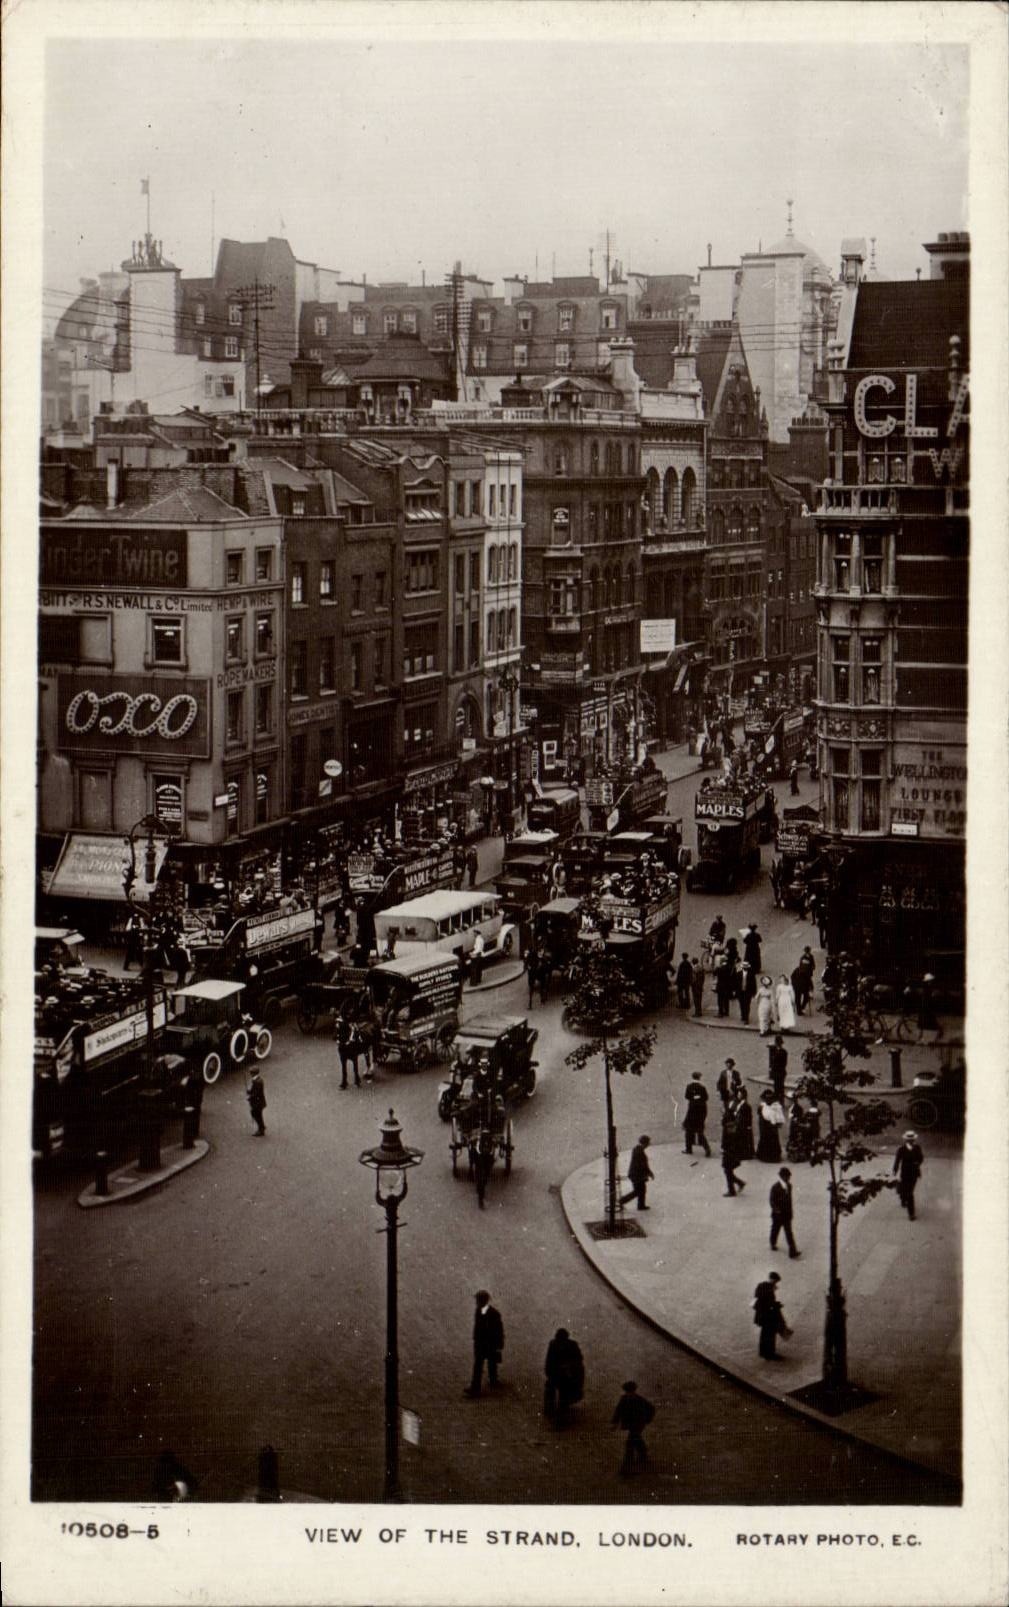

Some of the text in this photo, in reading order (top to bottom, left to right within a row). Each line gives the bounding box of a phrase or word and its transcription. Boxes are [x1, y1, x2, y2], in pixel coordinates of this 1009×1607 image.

[110, 534, 179, 579] Twine
[249, 591, 274, 608] WIRE
[65, 689, 198, 740] OXO
[922, 750, 943, 762] THE
[901, 787, 963, 803] LOUNGE
[696, 803, 745, 818] MAPLES
[405, 869, 431, 892] MAPLE
[581, 915, 643, 934] MLES
